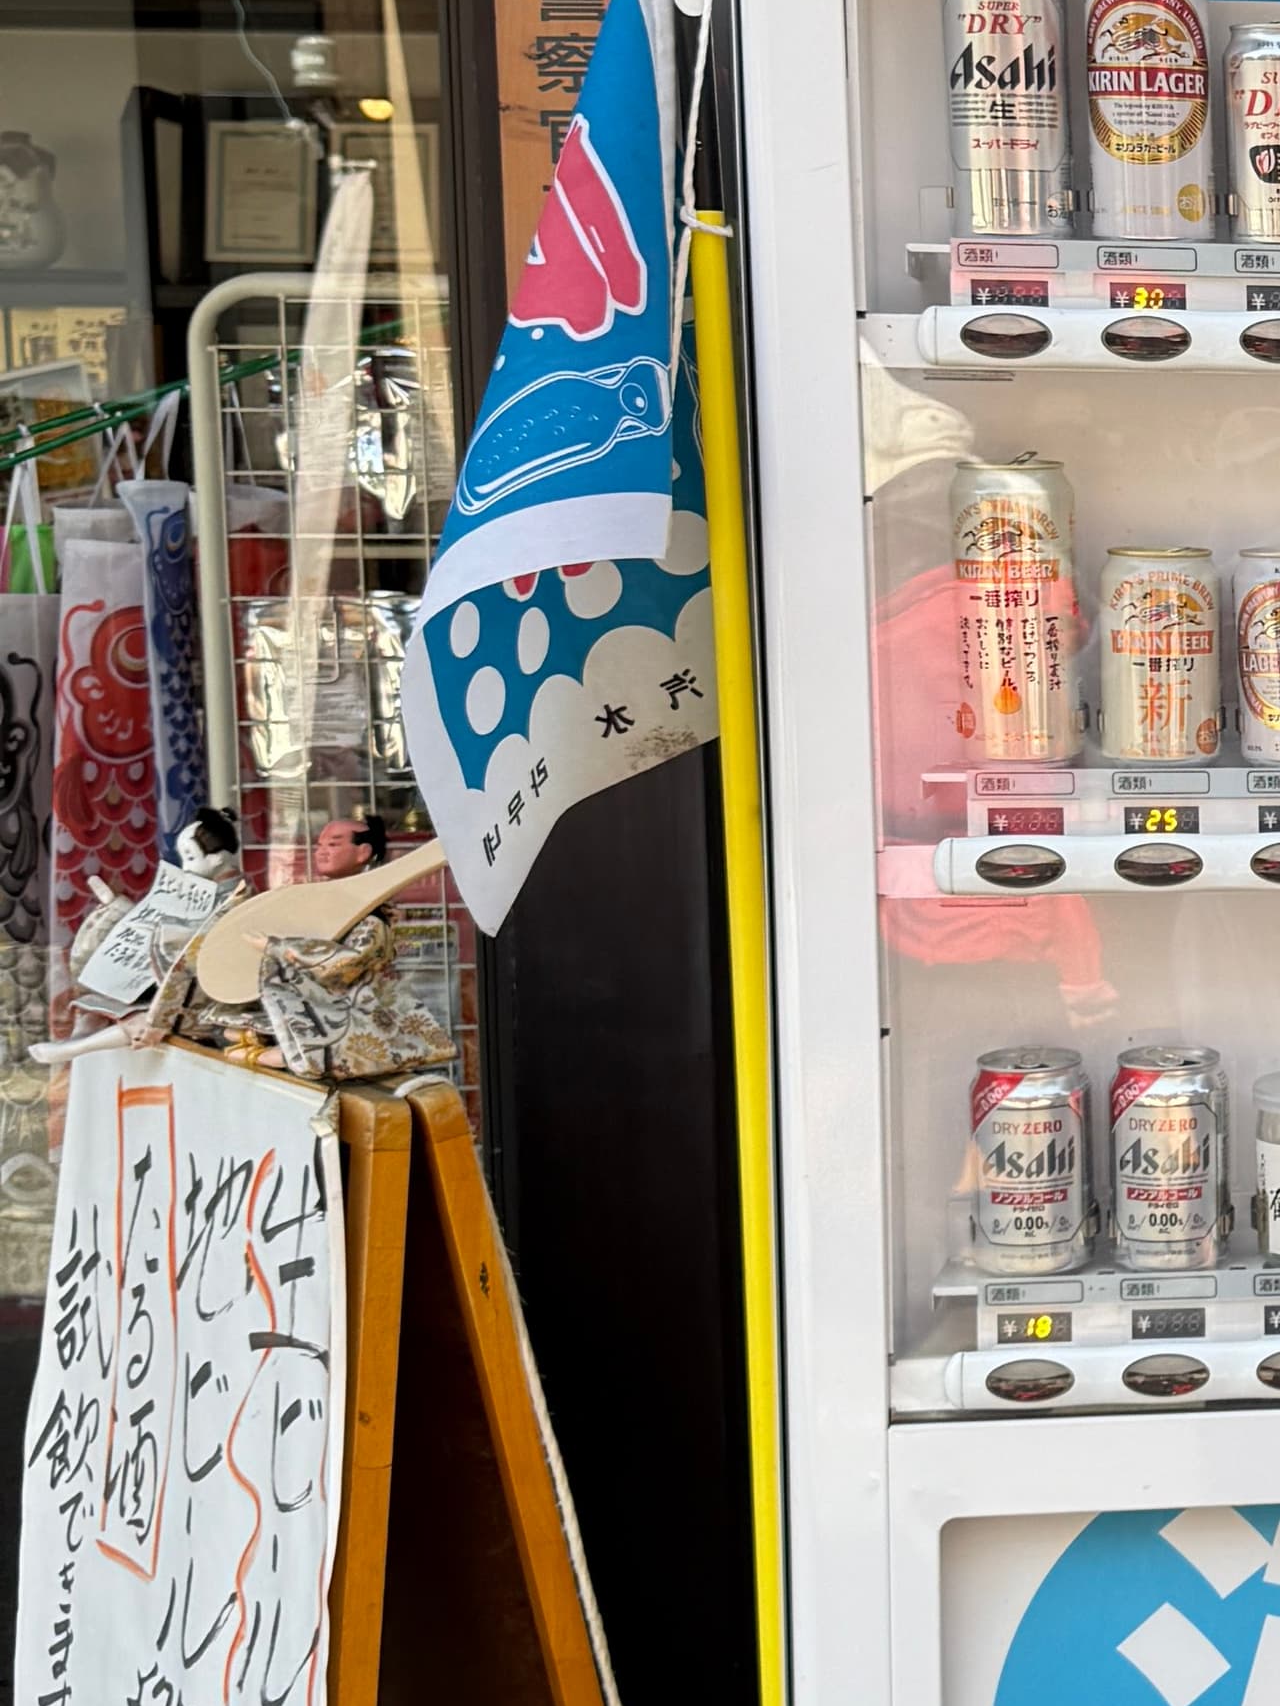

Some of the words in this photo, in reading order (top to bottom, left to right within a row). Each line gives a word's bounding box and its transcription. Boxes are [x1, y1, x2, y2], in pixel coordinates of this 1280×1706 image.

[978, 1, 1020, 12] SUPER
[950, 41, 1057, 92] Asahi
[1088, 68, 1136, 93] KIRIN
[1140, 70, 1206, 96] LAGER
[988, 100, 1016, 121] 生
[971, 138, 1041, 151] スーパードライ
[968, 588, 1040, 610] 一番搾り
[1136, 676, 1193, 733] 新
[983, 1135, 1075, 1179] Asahi
[1119, 1134, 1211, 1176] Asahi
